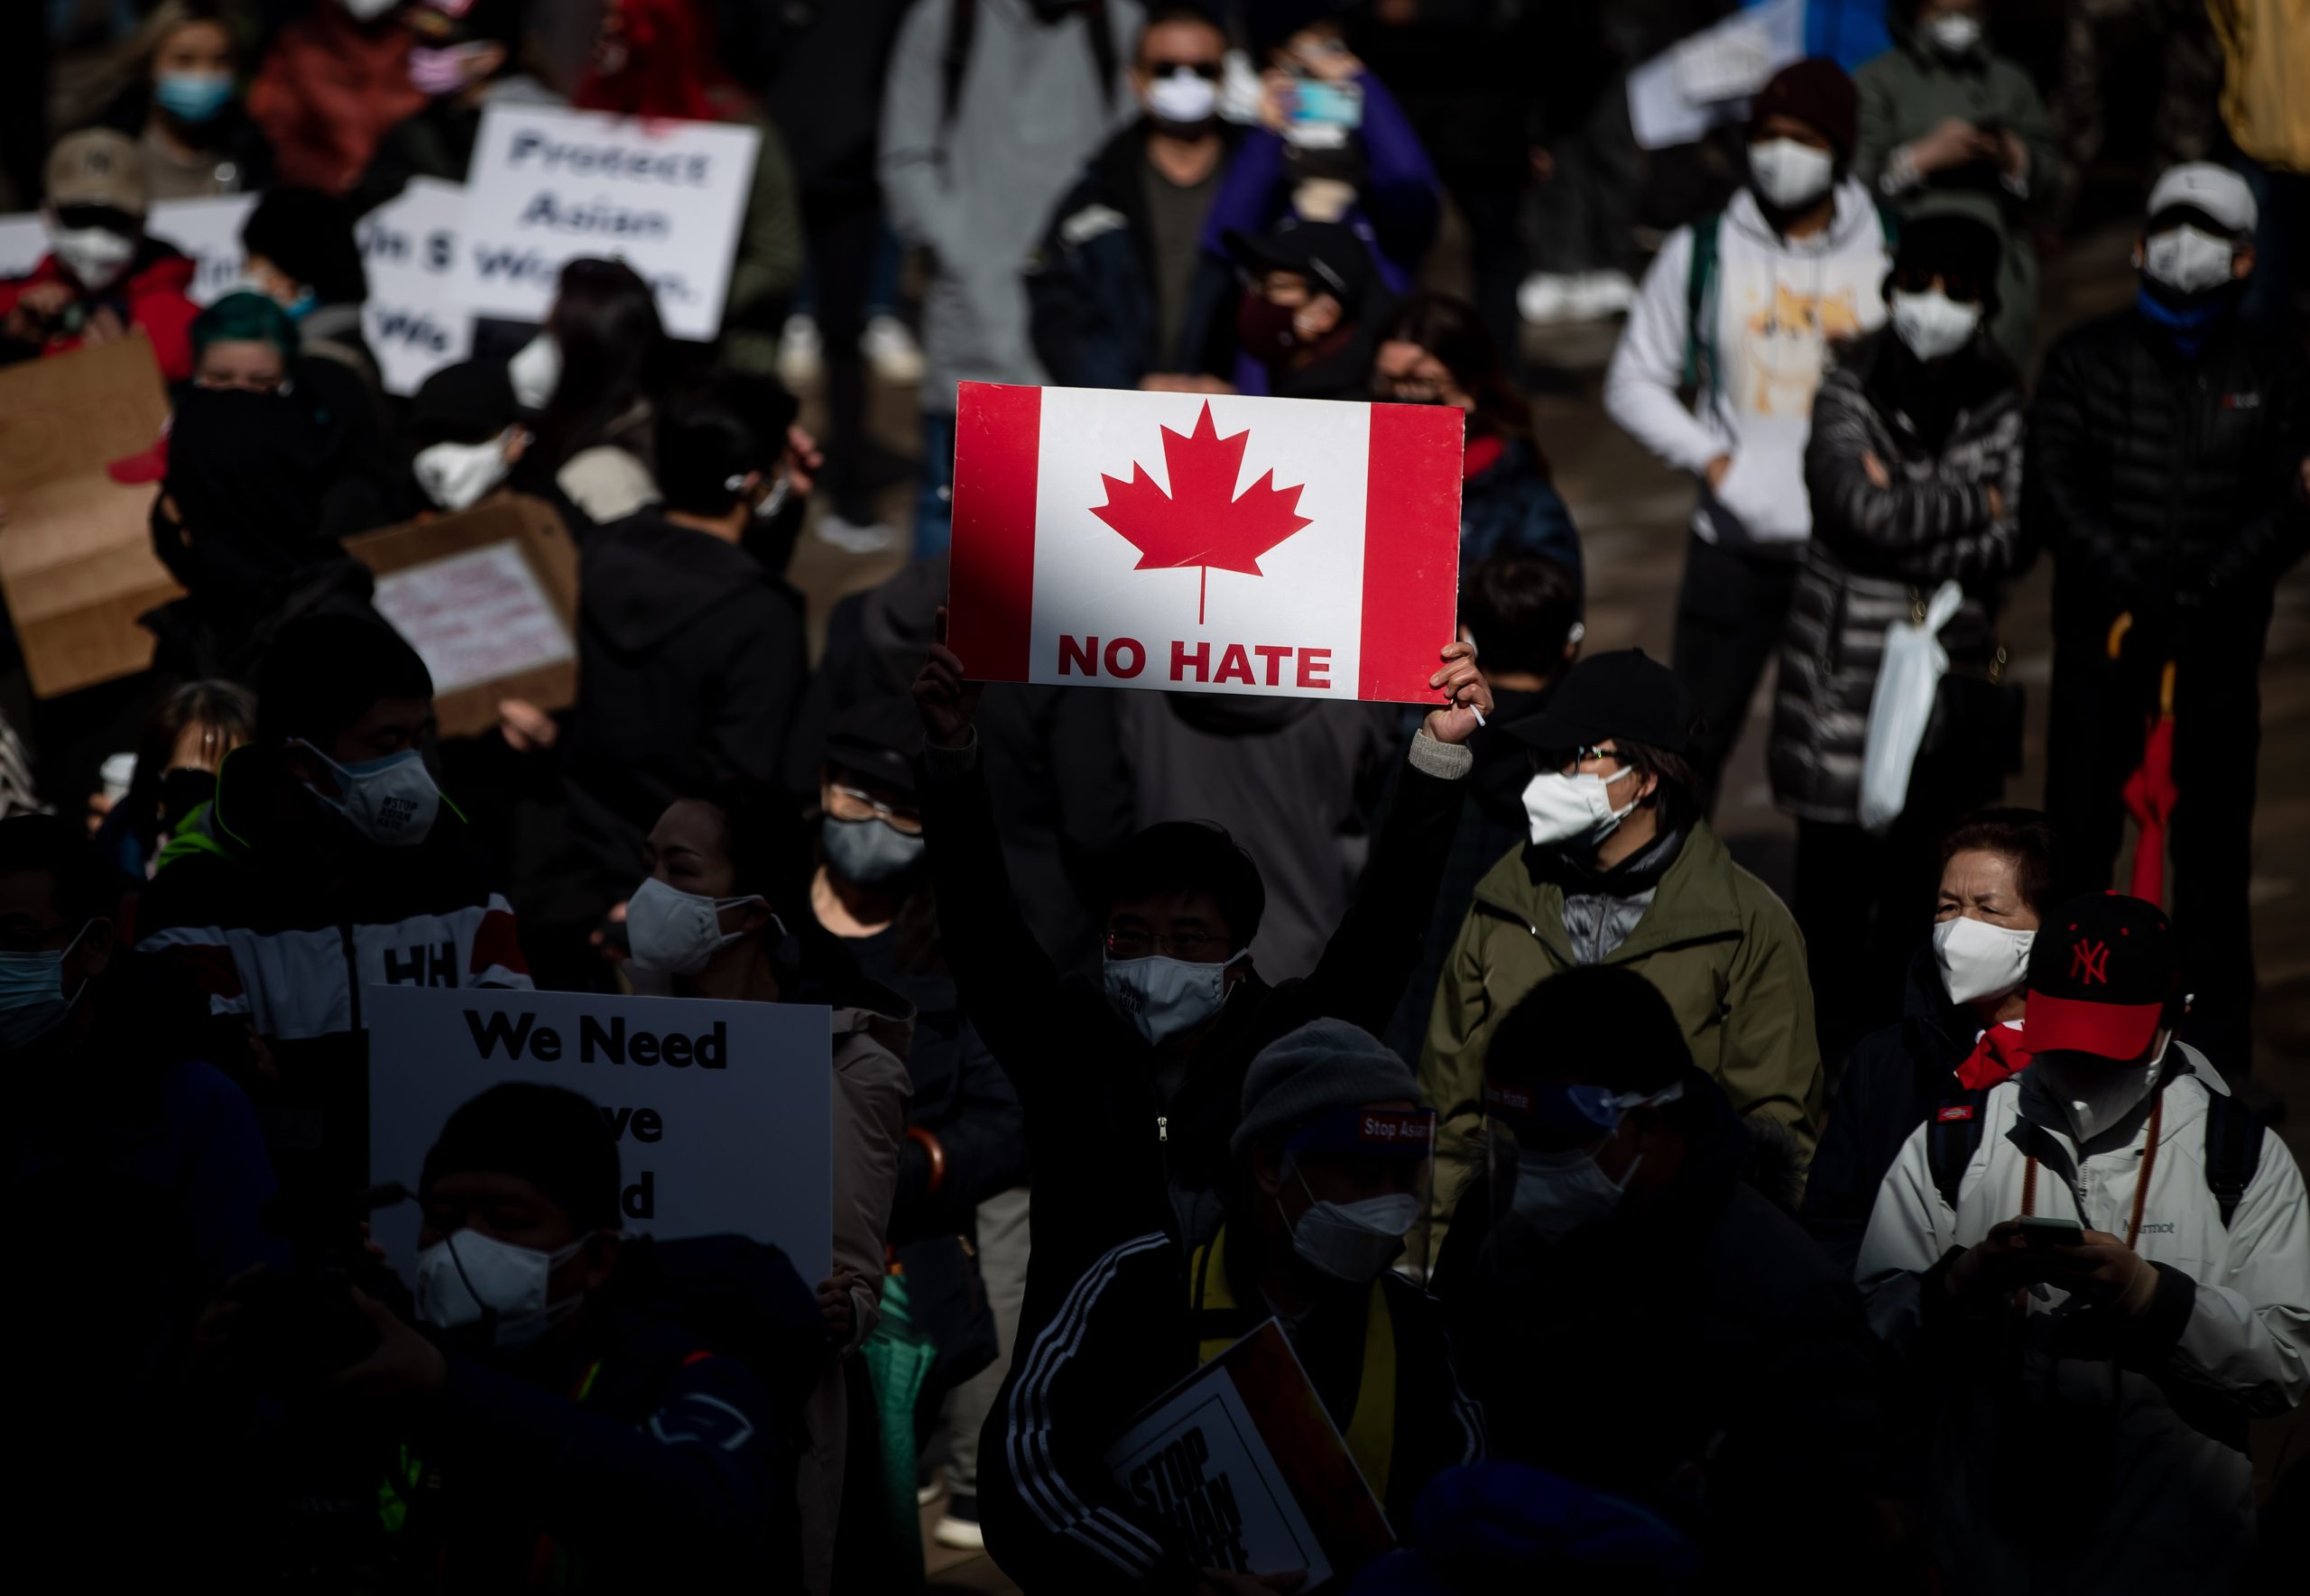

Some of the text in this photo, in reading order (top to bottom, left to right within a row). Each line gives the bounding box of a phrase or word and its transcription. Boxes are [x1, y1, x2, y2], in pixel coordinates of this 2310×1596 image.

[509, 132, 712, 185] Protect
[521, 191, 670, 238] Asian
[1058, 634, 1332, 688] NO HATE
[383, 942, 457, 988] HH
[2068, 937, 2113, 988] NY
[463, 1010, 727, 1069] We Need
[1363, 1117, 1397, 1141] Stop
[1130, 1427, 1209, 1518] STOP
